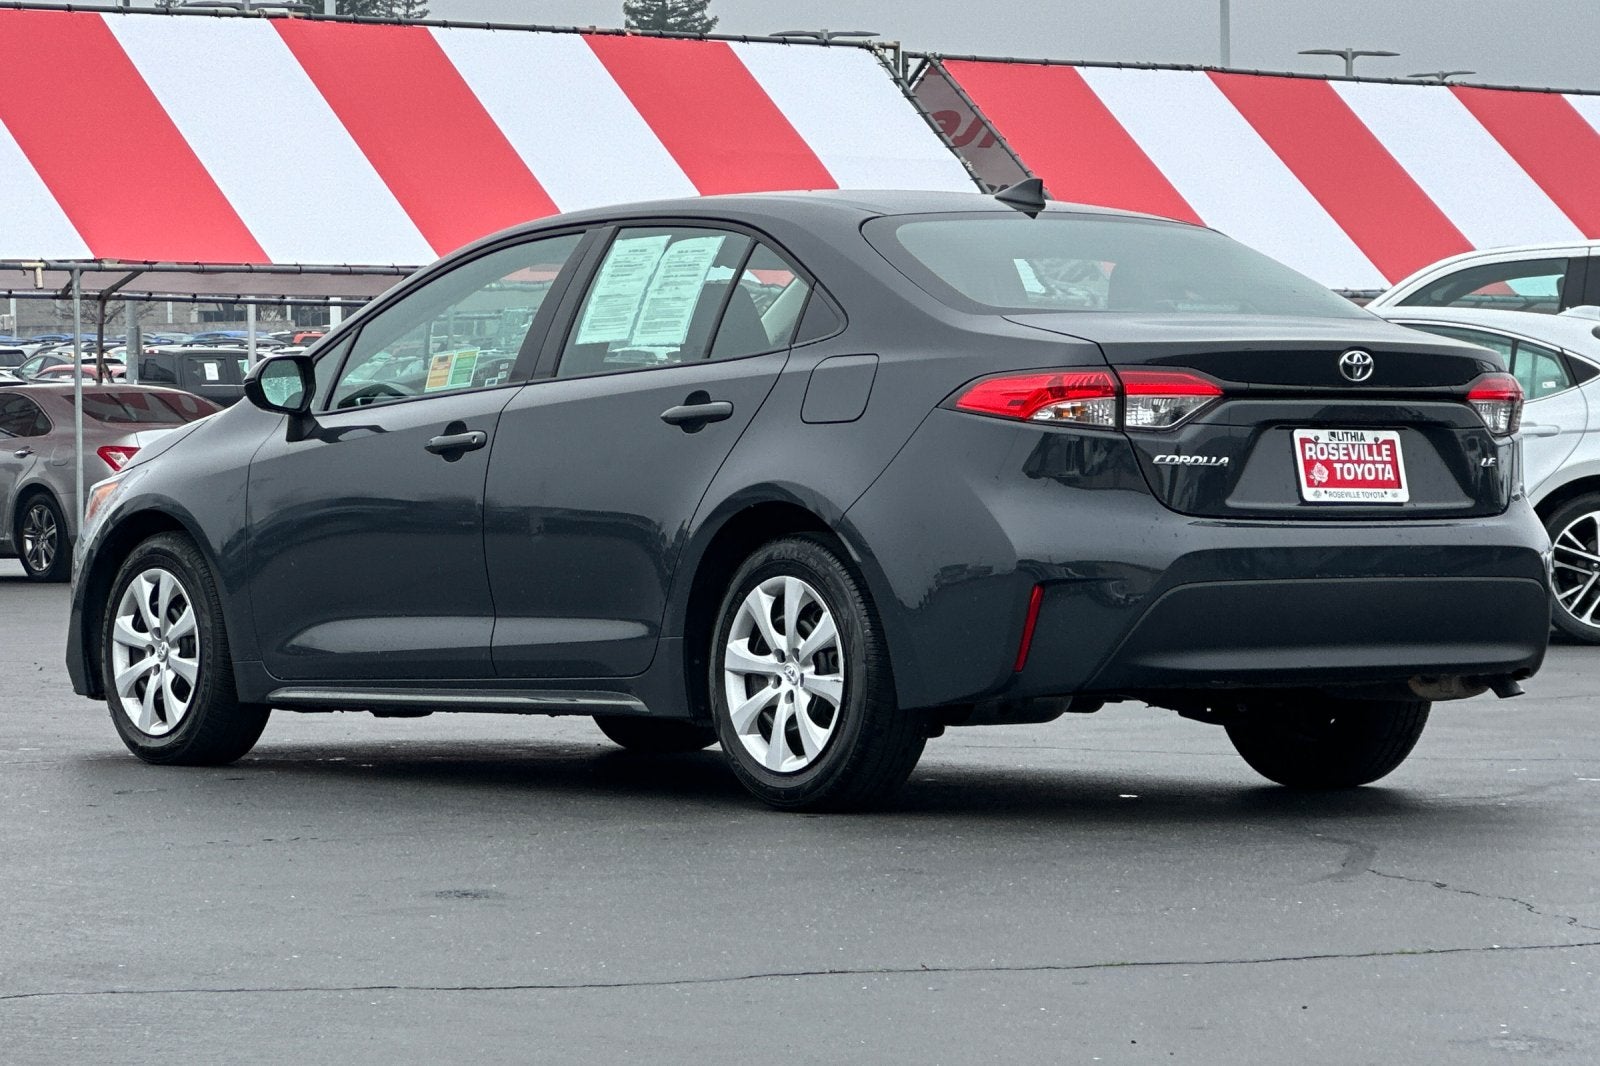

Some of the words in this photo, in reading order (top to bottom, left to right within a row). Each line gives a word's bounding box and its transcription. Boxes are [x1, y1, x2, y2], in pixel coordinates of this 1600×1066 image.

[1337, 432, 1366, 442] LITHIA
[1306, 444, 1391, 461] ROSEVILLE
[1153, 455, 1229, 466] COROLLA
[1480, 458, 1496, 467] LE
[1333, 463, 1395, 480] TOYOTA
[1361, 491, 1385, 499] TOYOTA
